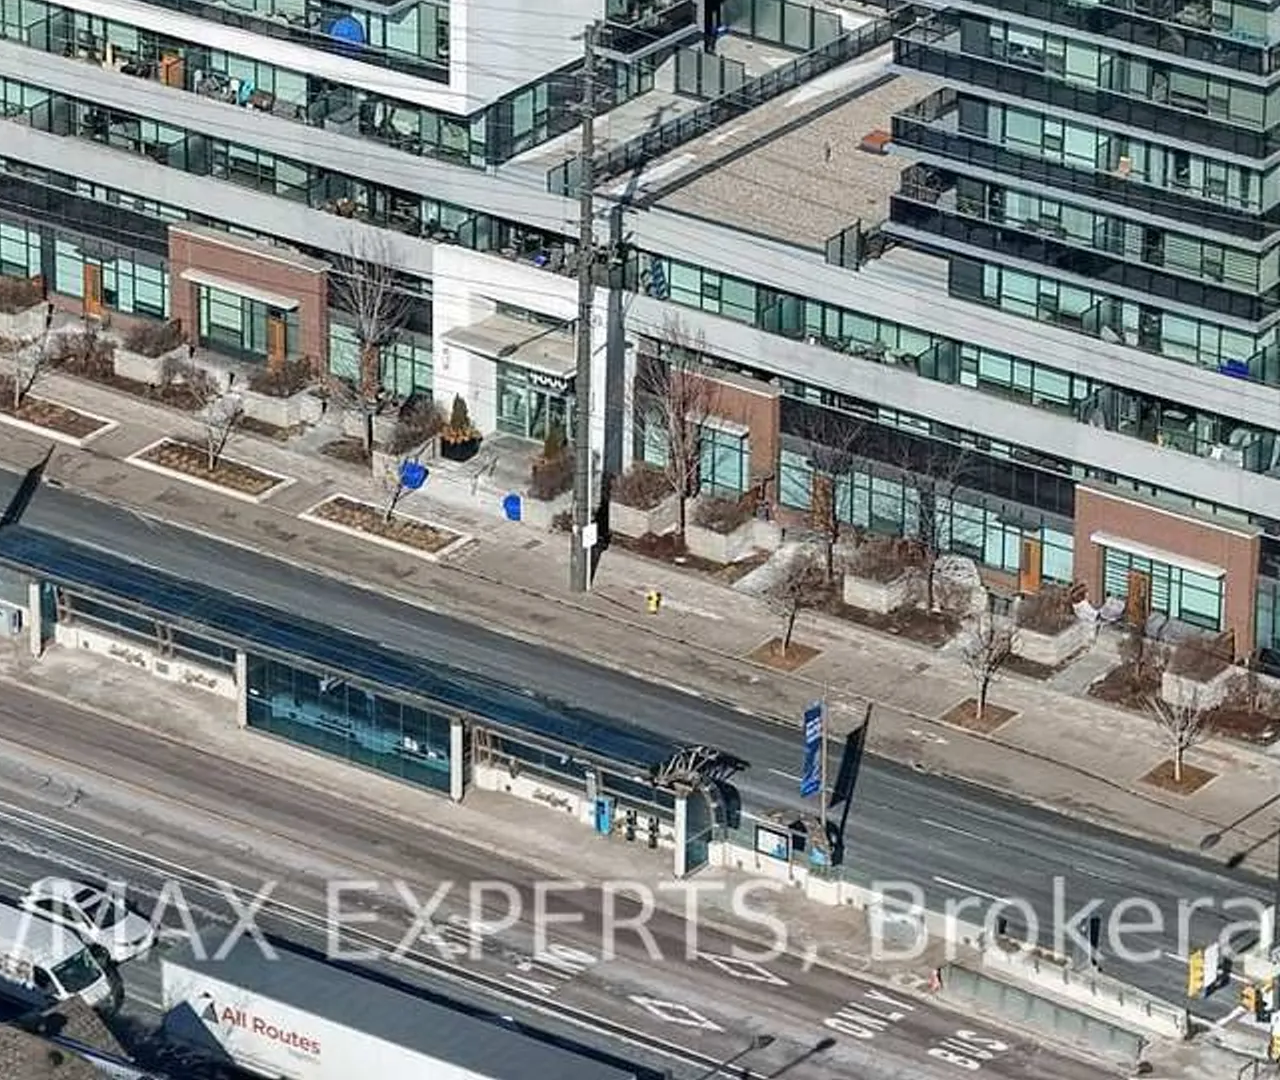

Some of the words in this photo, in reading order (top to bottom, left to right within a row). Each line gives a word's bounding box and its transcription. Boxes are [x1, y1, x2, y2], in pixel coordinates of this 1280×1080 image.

[222, 1006, 247, 1029] All
[253, 1016, 321, 1055] Routes
[823, 990, 915, 1039] ONLY
[927, 1029, 1009, 1071] BUS
